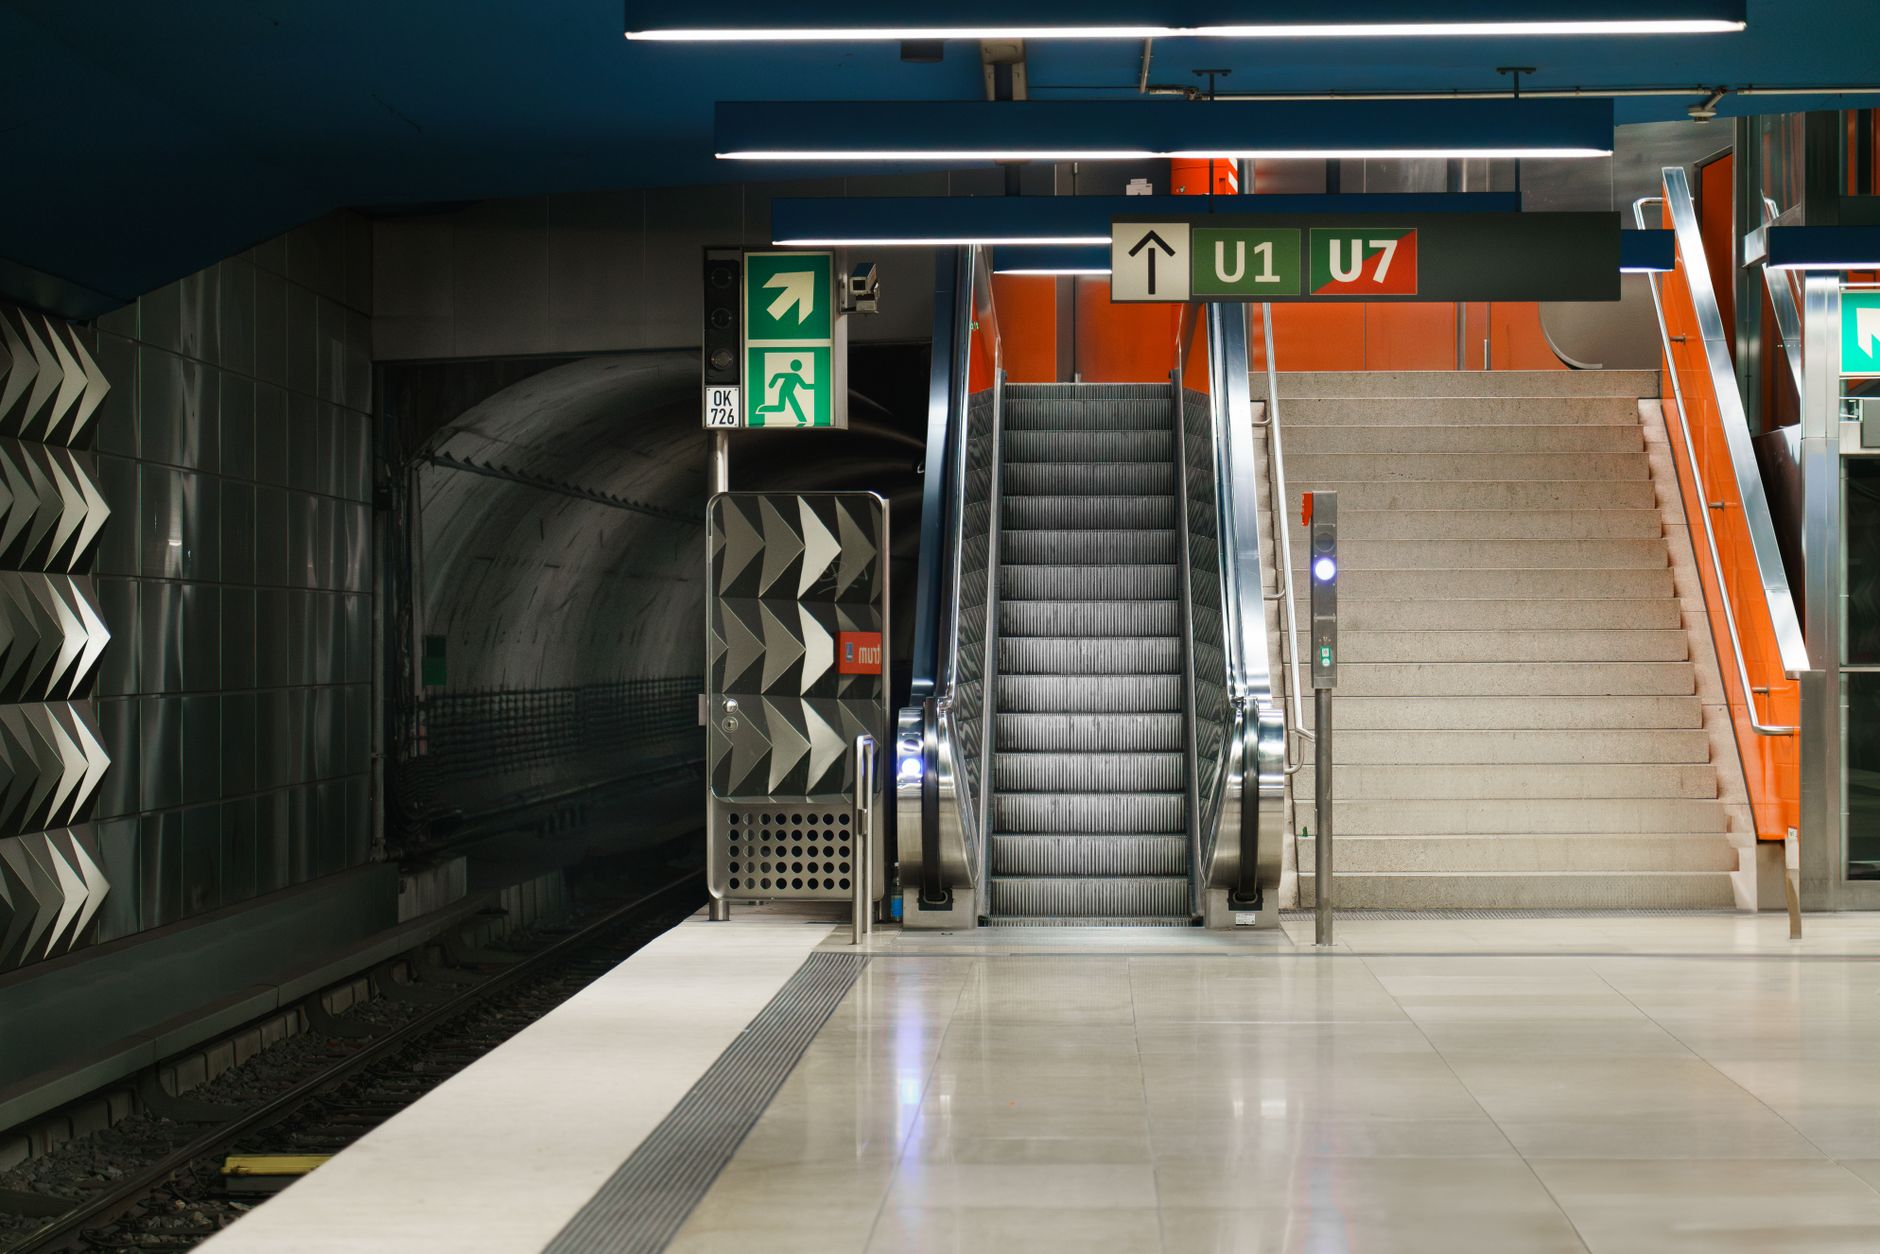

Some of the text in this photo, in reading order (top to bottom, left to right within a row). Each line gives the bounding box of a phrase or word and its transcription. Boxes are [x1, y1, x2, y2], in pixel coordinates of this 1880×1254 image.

[1215, 239, 1398, 283] U1 U7
[713, 390, 732, 407] OK
[710, 408, 735, 425] 726
